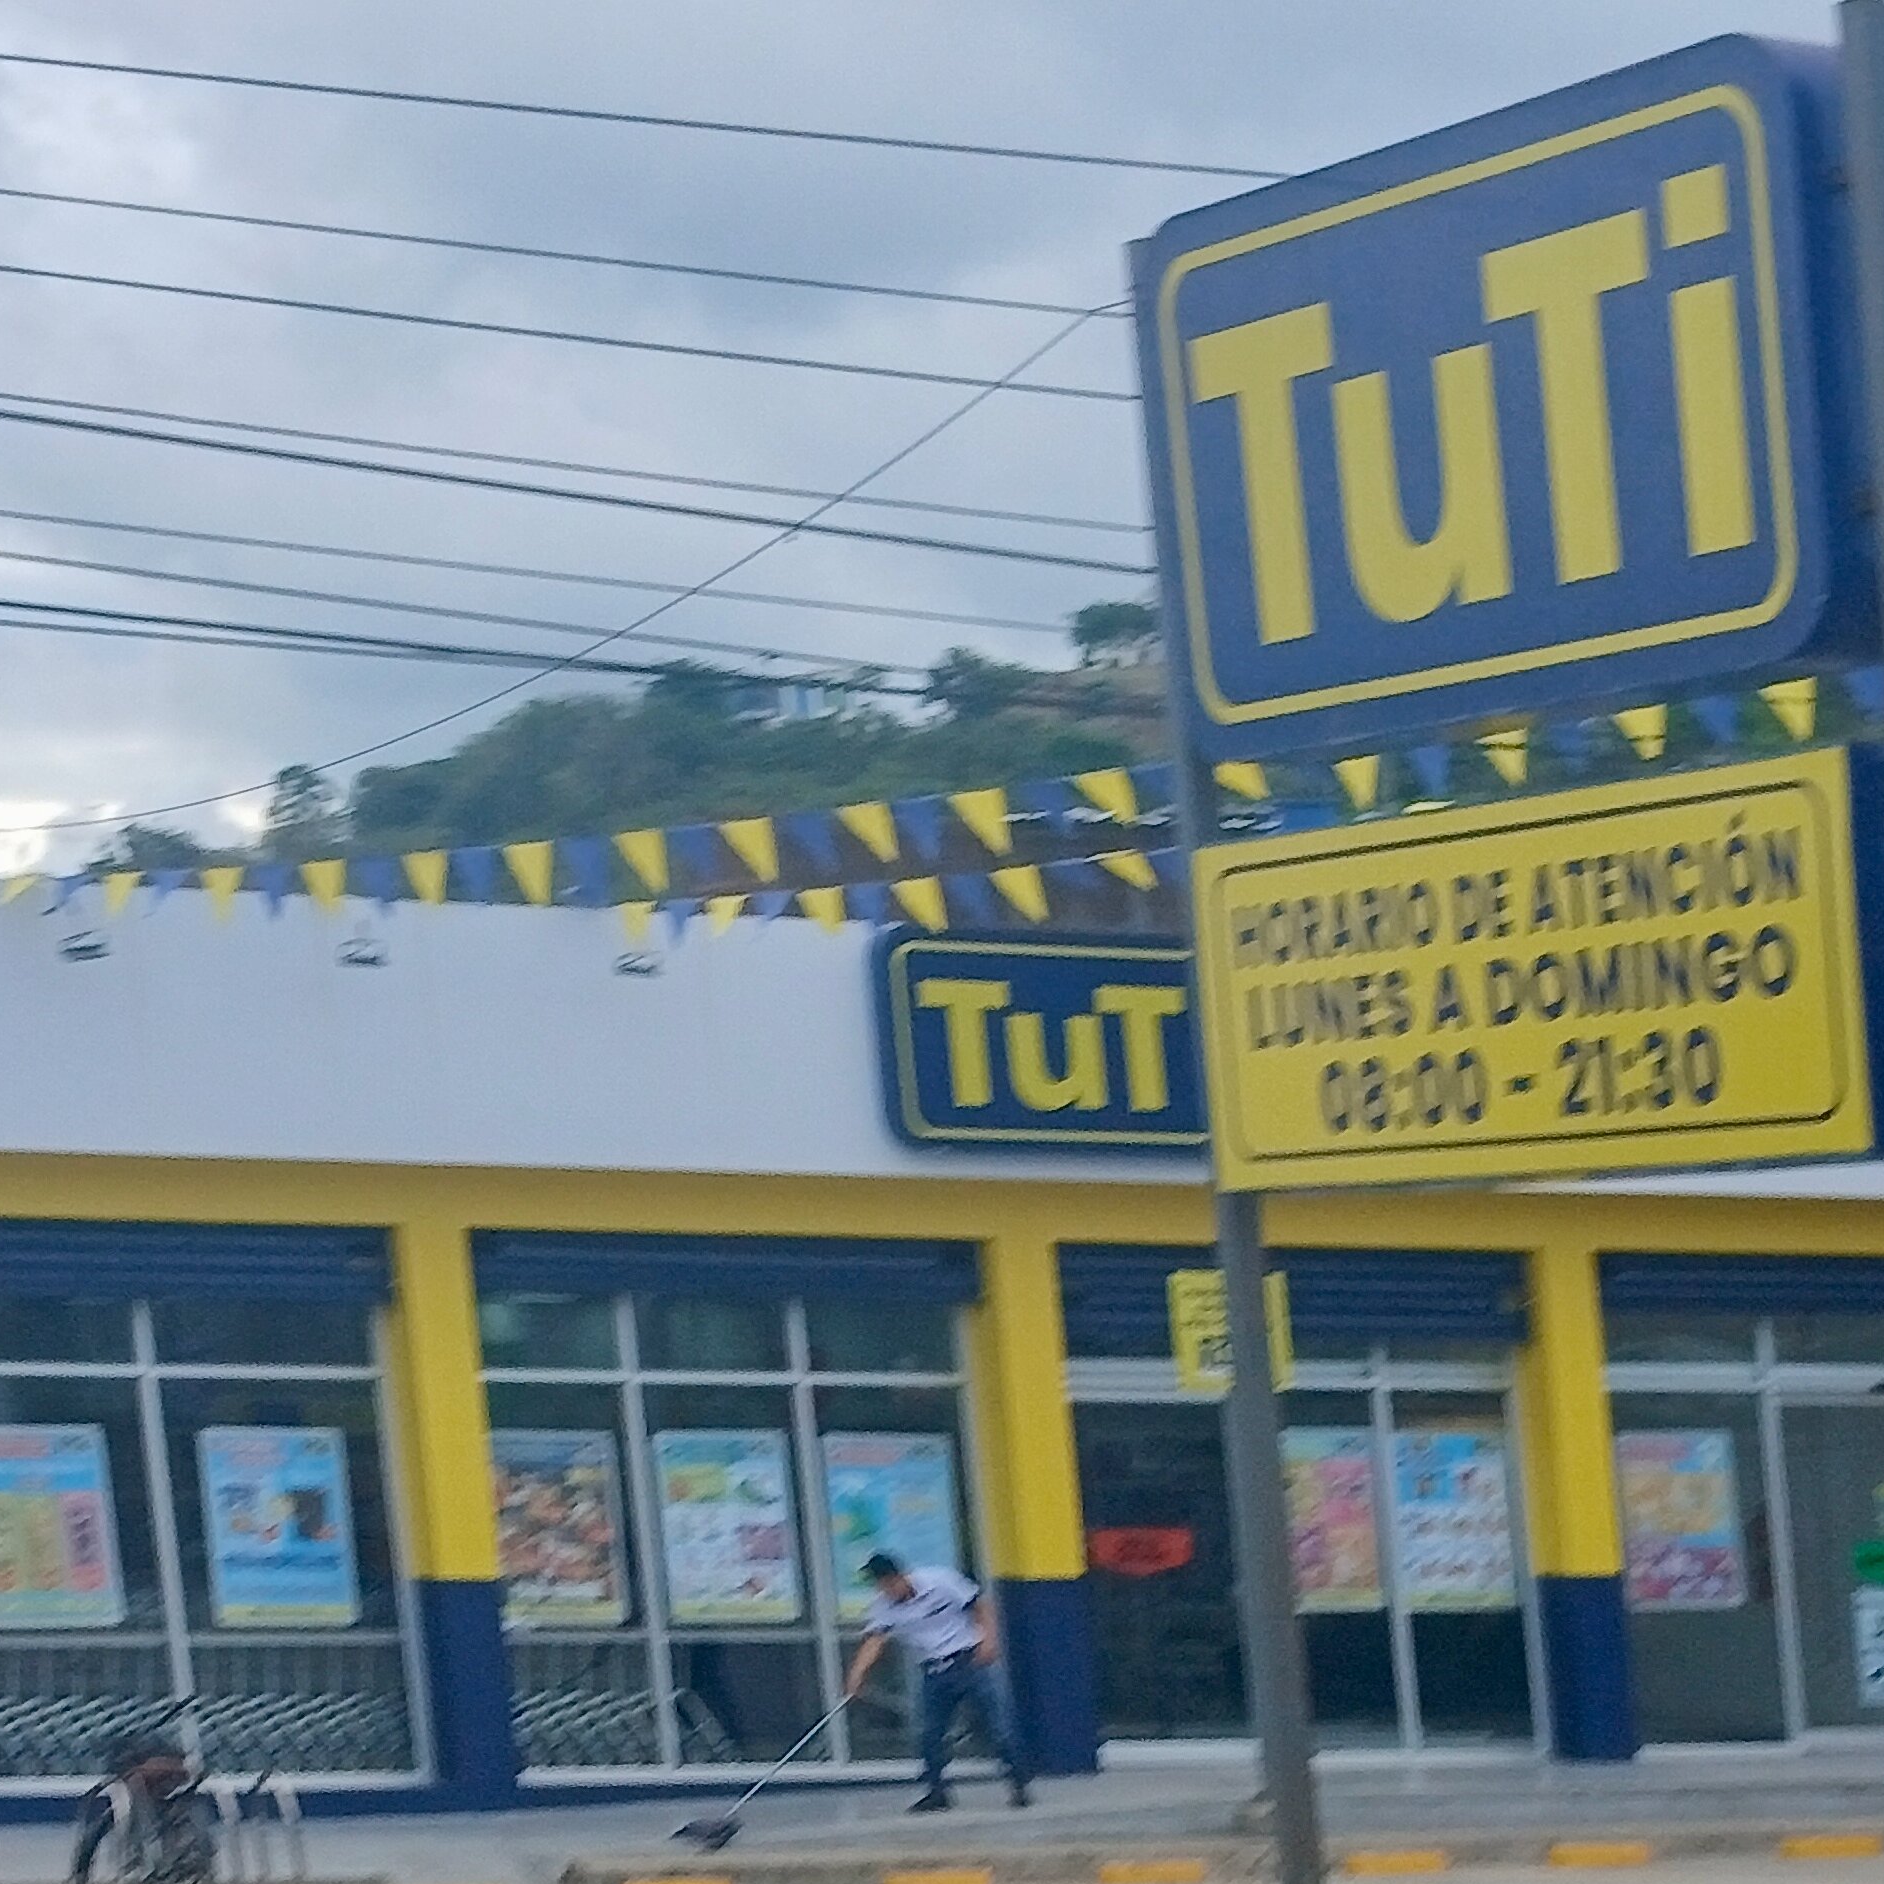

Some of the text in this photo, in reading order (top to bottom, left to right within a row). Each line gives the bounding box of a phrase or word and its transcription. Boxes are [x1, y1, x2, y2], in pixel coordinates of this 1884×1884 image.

[1188, 164, 1756, 645] TuTi
[1232, 810, 1804, 968] HORARIO DE ATENCIÓN
[917, 976, 1186, 1113] TuT
[1246, 924, 1798, 1052] LUNES A DOMINGO
[1321, 1046, 1490, 1136] 08:00
[1557, 1024, 1723, 1118] 21:30
